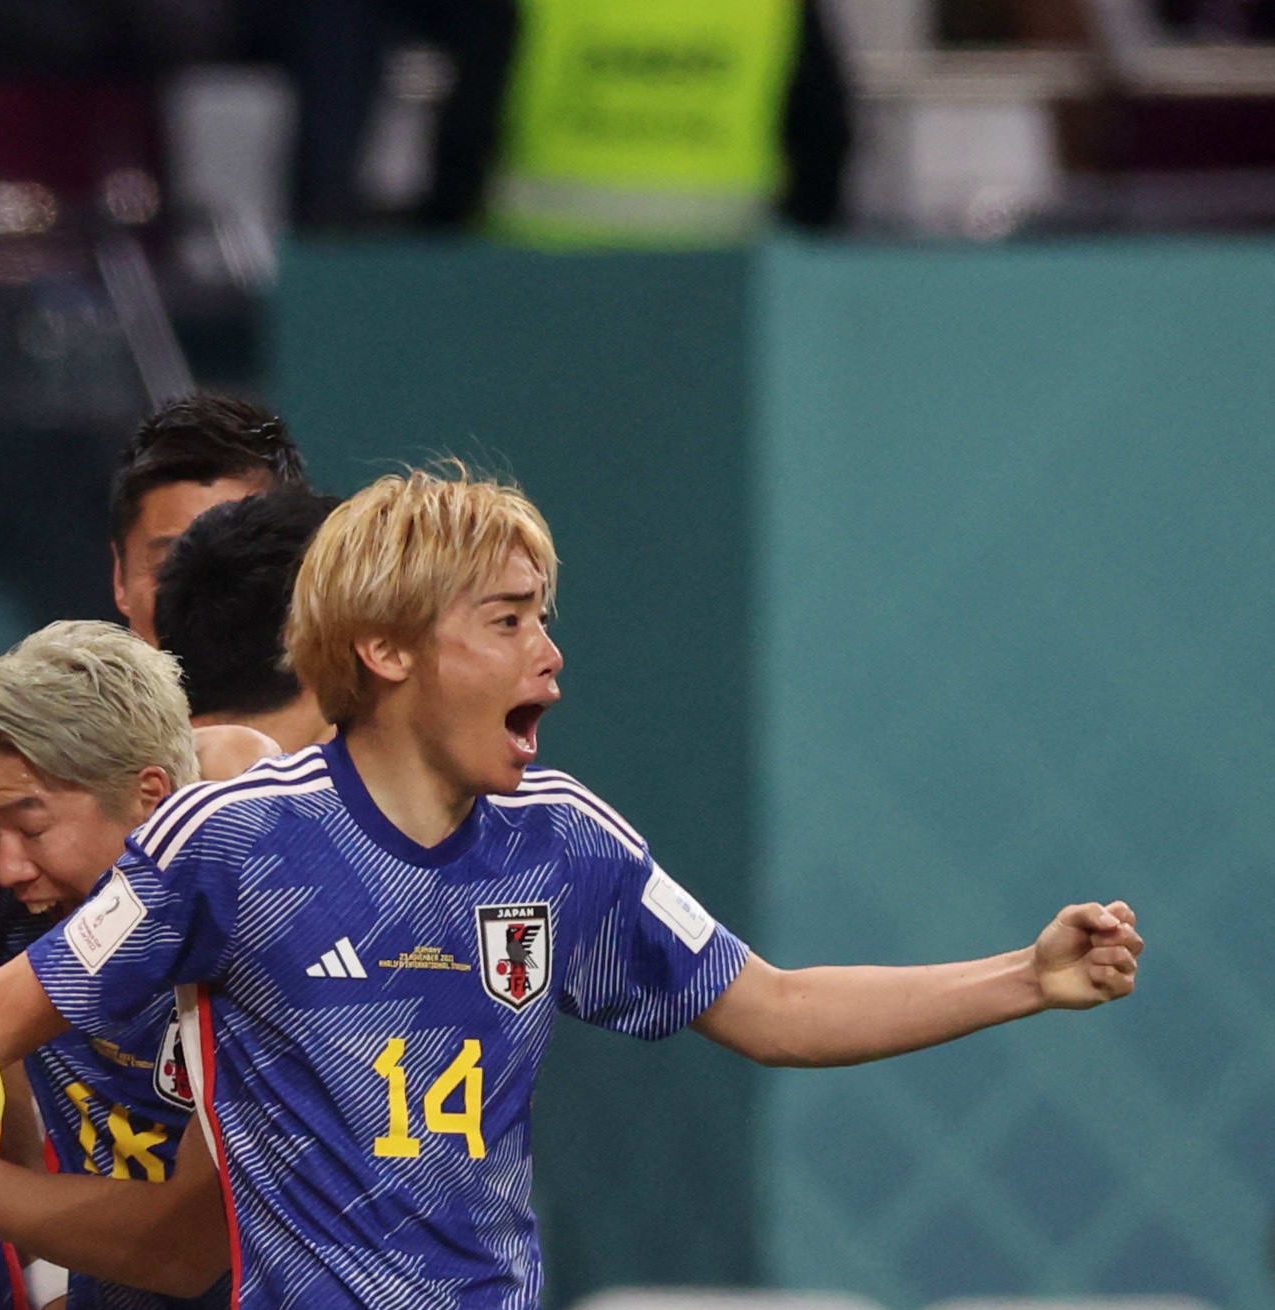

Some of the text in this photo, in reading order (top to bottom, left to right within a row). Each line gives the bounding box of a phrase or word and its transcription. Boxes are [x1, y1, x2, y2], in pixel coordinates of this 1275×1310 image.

[498, 908, 535, 918] JAPAN
[504, 976, 533, 992] JFA
[372, 1038, 487, 1159] 14
